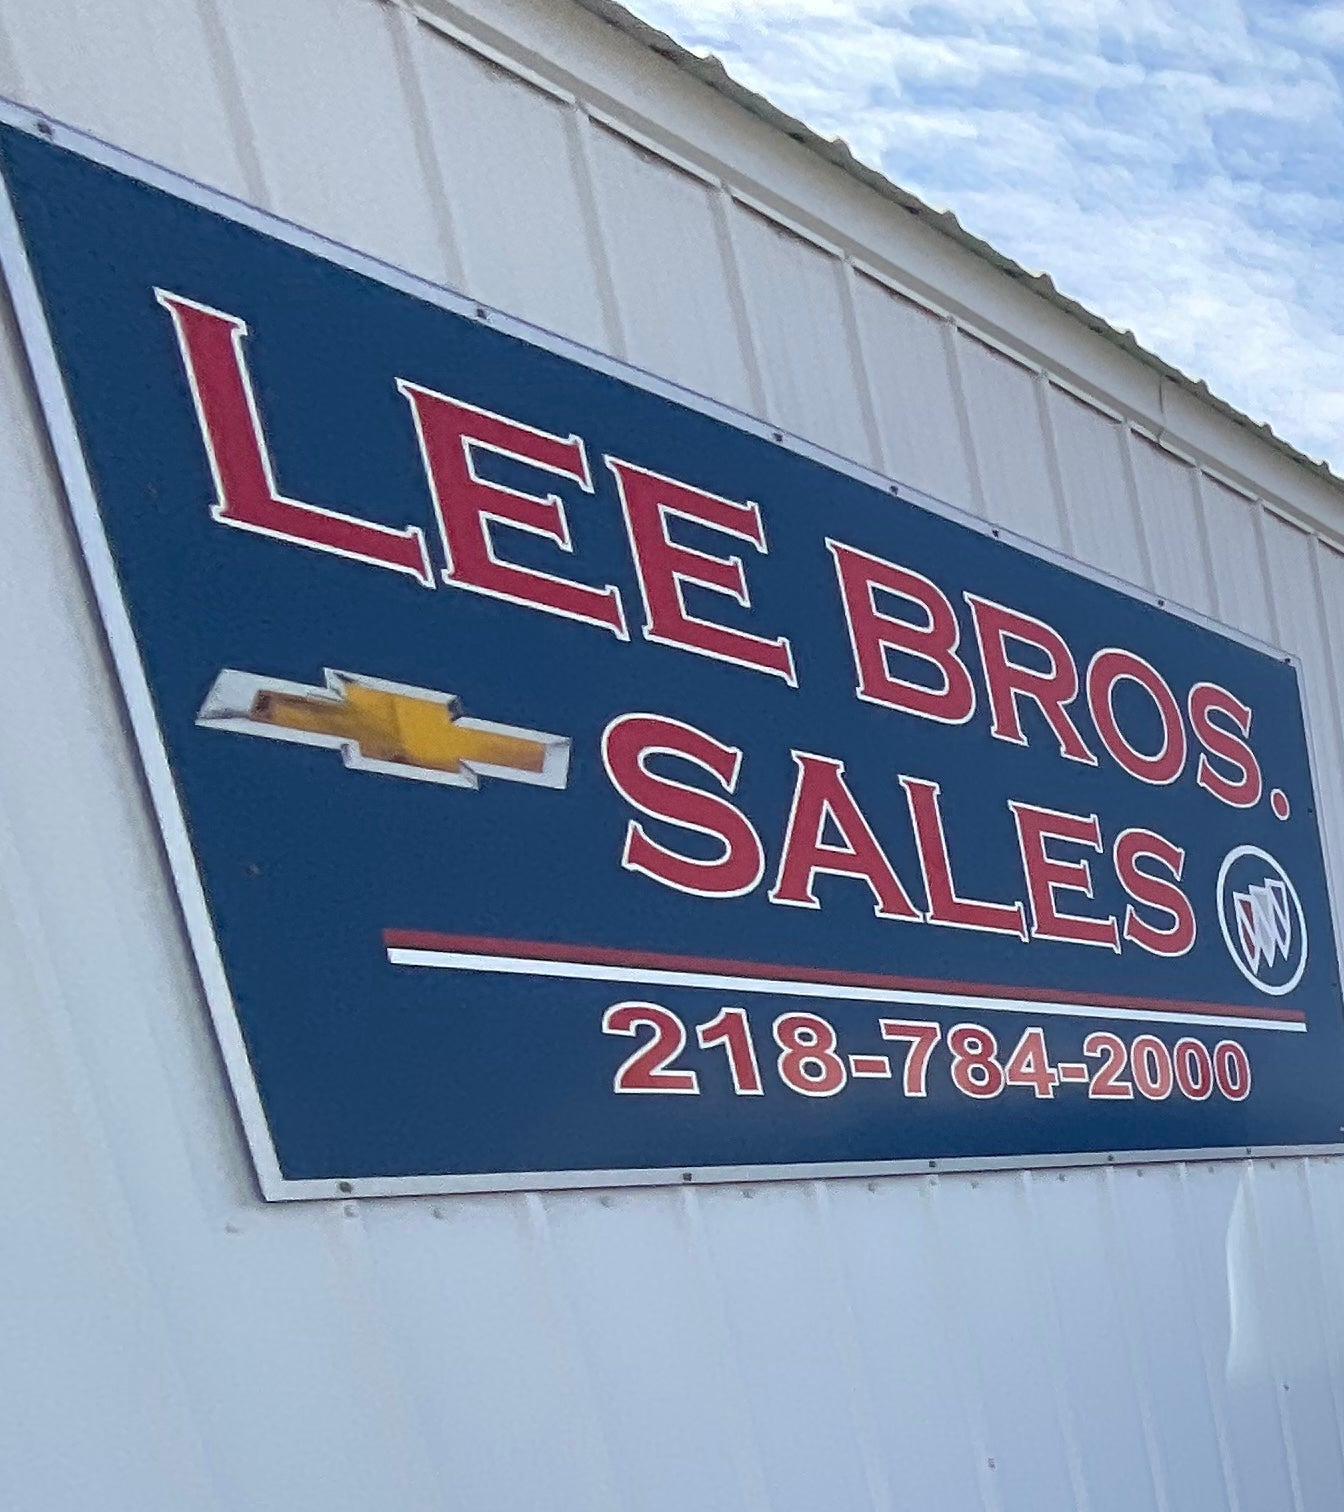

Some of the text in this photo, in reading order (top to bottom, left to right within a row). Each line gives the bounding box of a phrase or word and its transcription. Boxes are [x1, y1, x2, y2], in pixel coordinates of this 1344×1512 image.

[152, 286, 1290, 821] LEE BROS.
[600, 713, 1198, 958] SALES
[601, 1001, 1251, 1101] 218-784-2000
